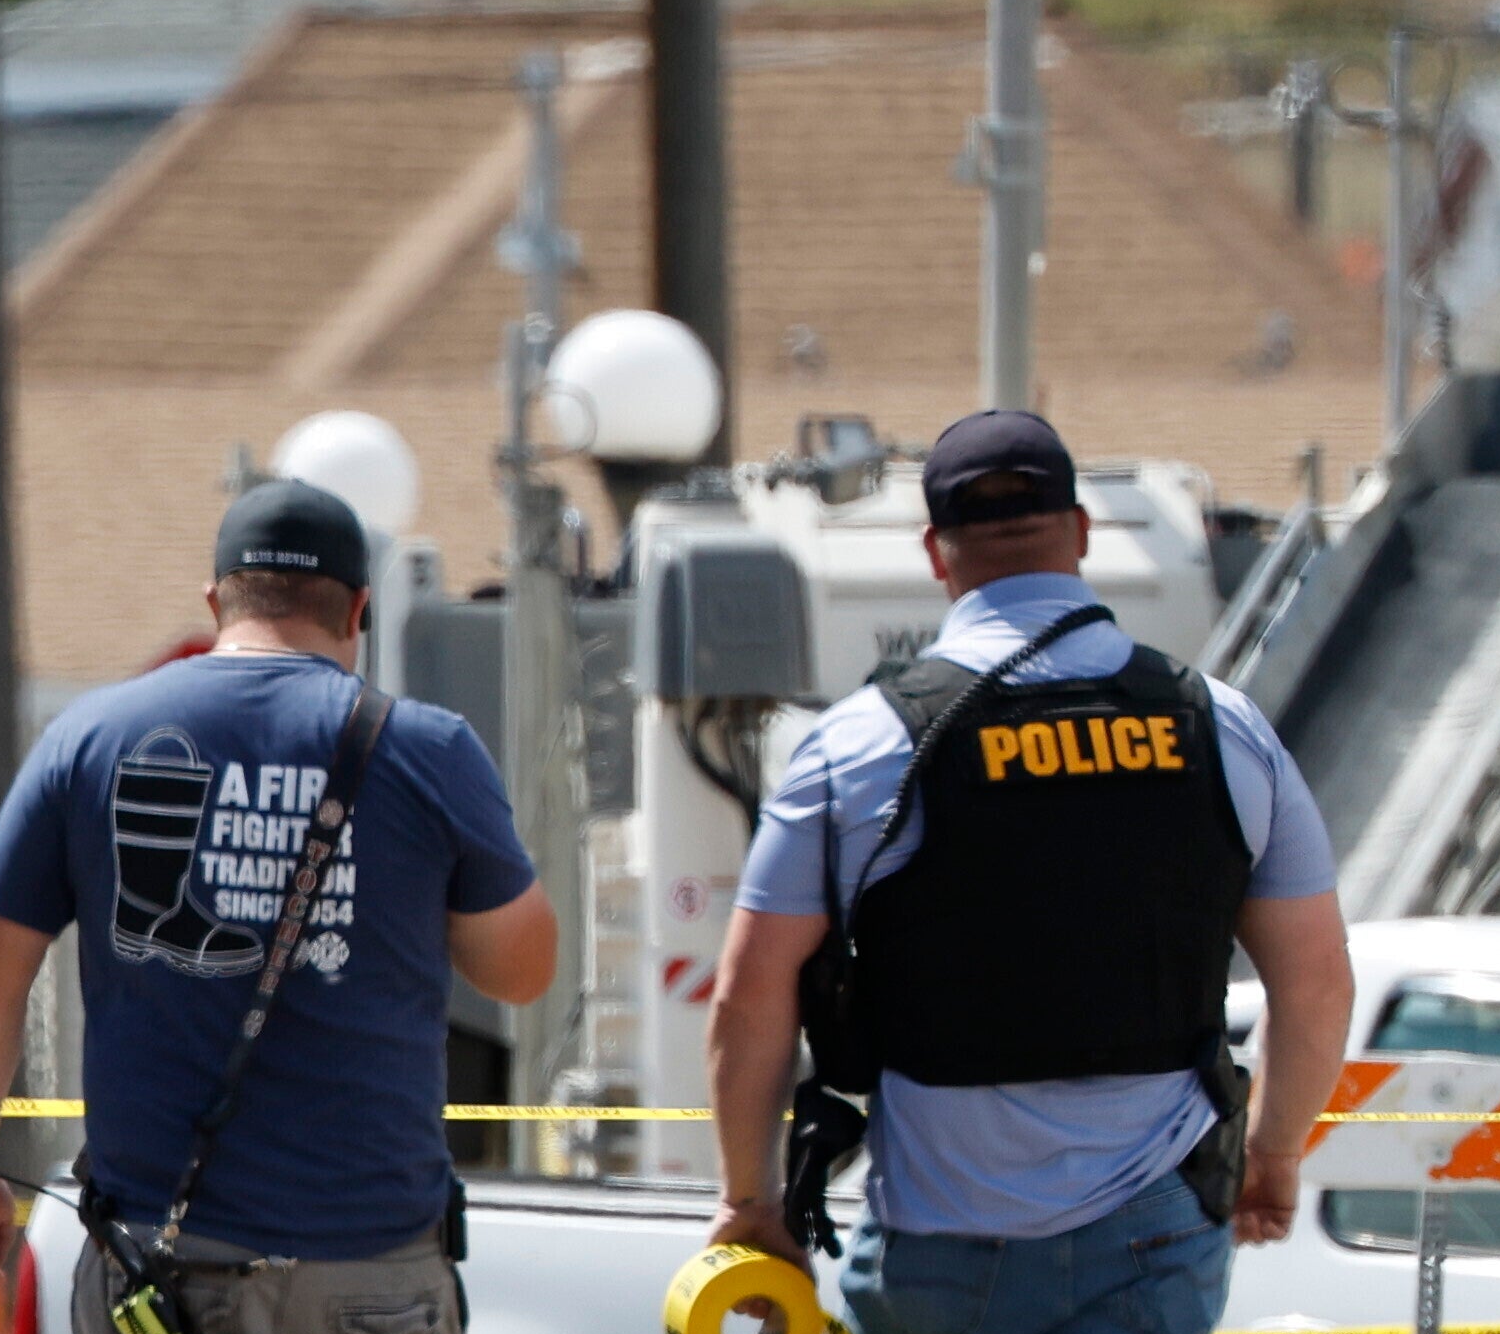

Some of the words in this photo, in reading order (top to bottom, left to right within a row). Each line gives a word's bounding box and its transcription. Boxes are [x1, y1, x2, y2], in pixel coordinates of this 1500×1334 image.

[978, 715, 1185, 782] POLICE
[217, 761, 250, 808] A
[258, 764, 355, 815] FIR
[211, 810, 354, 858] FIGHTR
